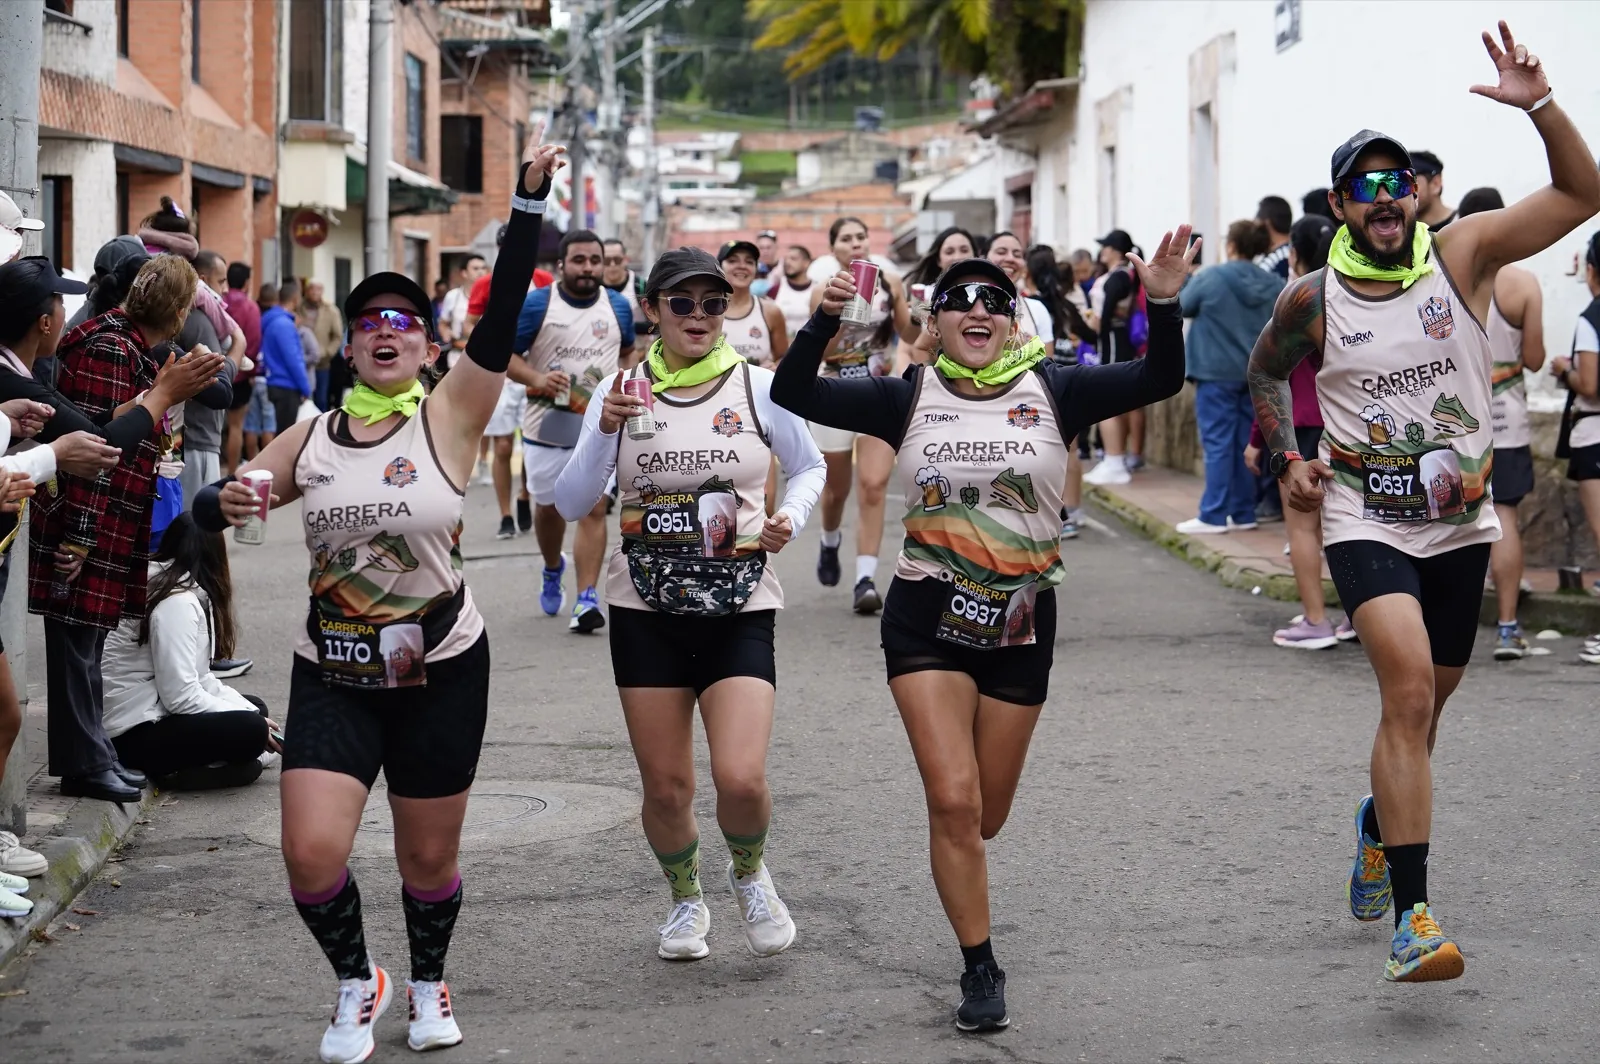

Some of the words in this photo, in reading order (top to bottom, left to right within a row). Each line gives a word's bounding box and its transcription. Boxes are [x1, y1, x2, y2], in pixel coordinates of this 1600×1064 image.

[1361, 357, 1457, 393] CARRERA
[1371, 379, 1436, 400] CERVECERA
[923, 441, 1037, 456] CARRERA
[636, 449, 740, 467] CARRERA
[928, 454, 1006, 464] CERVECERA
[1362, 454, 1415, 467] CARRERA
[641, 462, 712, 474] CERVECERA
[1366, 463, 1400, 472] CERVECERA
[1369, 472, 1414, 495] 0637
[651, 493, 695, 505] ARRERA
[306, 501, 412, 526] CARRERA
[647, 512, 693, 533] 0951
[312, 518, 379, 533] CERVECERA
[954, 574, 1007, 600] CARRERA
[954, 584, 991, 603] CERVECERA
[951, 595, 1002, 626] 0937
[320, 620, 375, 635] CARRERA
[322, 629, 359, 639] CERVECERA
[325, 639, 371, 663] 1170
